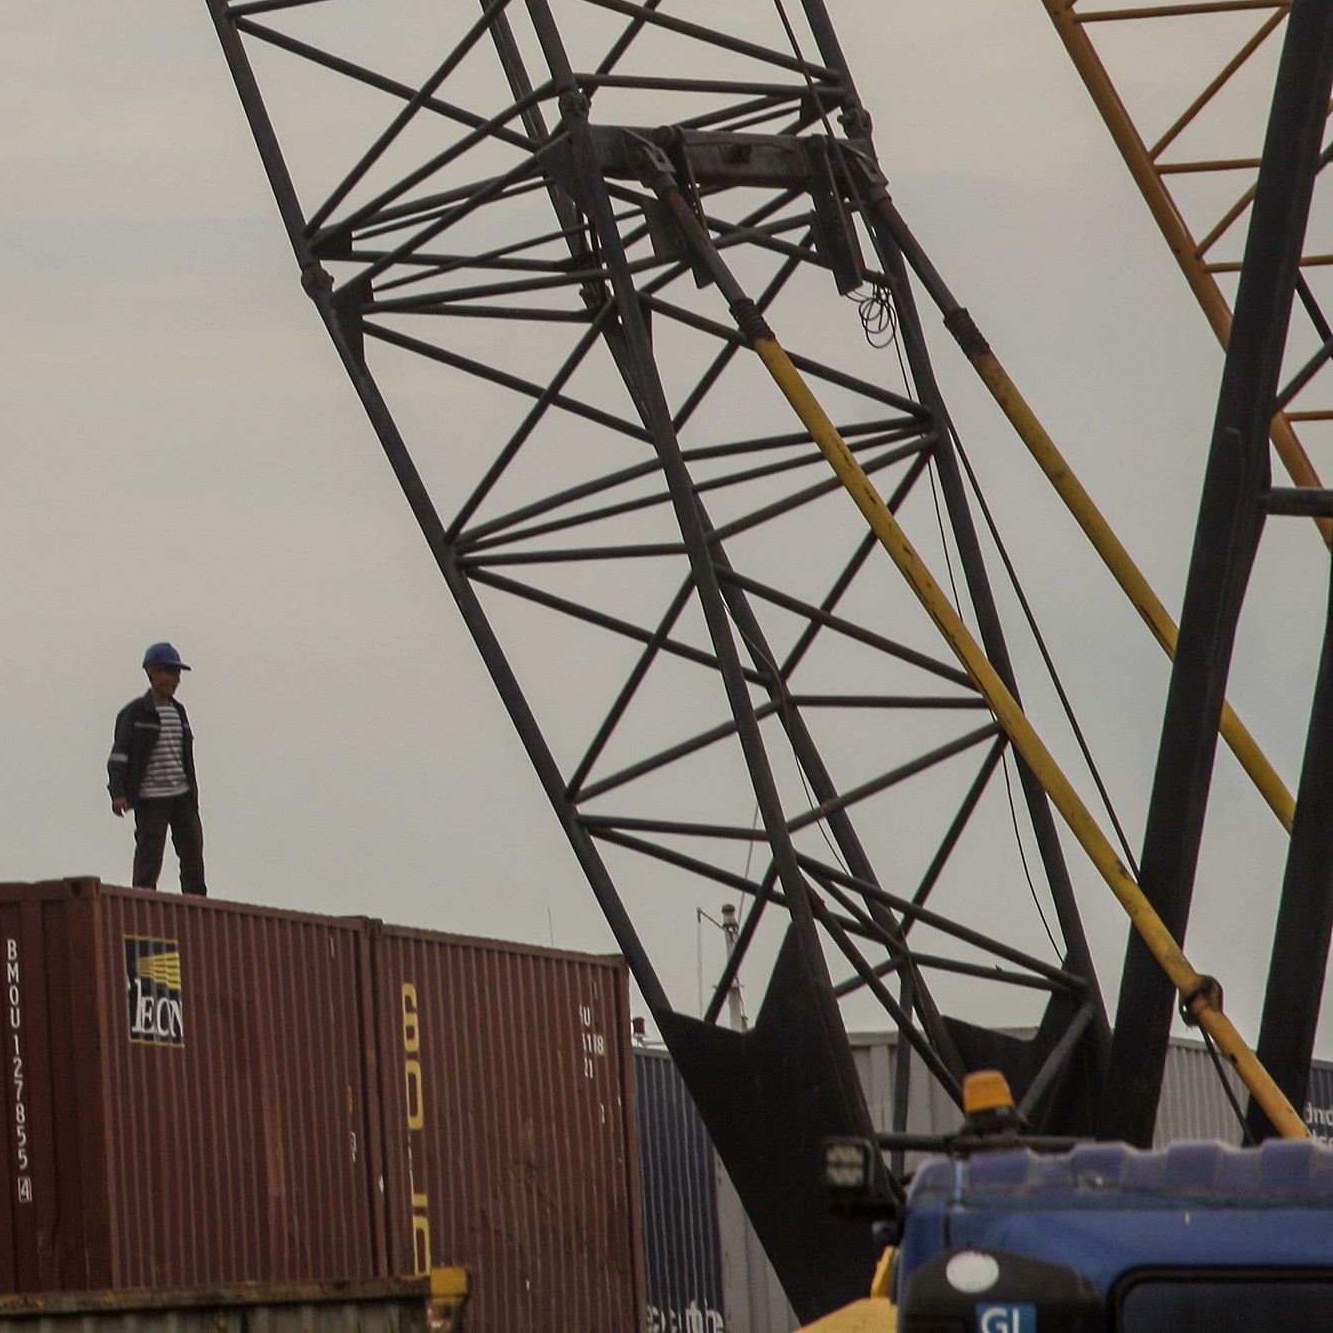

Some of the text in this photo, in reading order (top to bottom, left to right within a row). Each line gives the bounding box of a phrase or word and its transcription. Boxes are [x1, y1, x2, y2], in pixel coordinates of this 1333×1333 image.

[7, 938, 32, 1203] BMOU 127855 4
